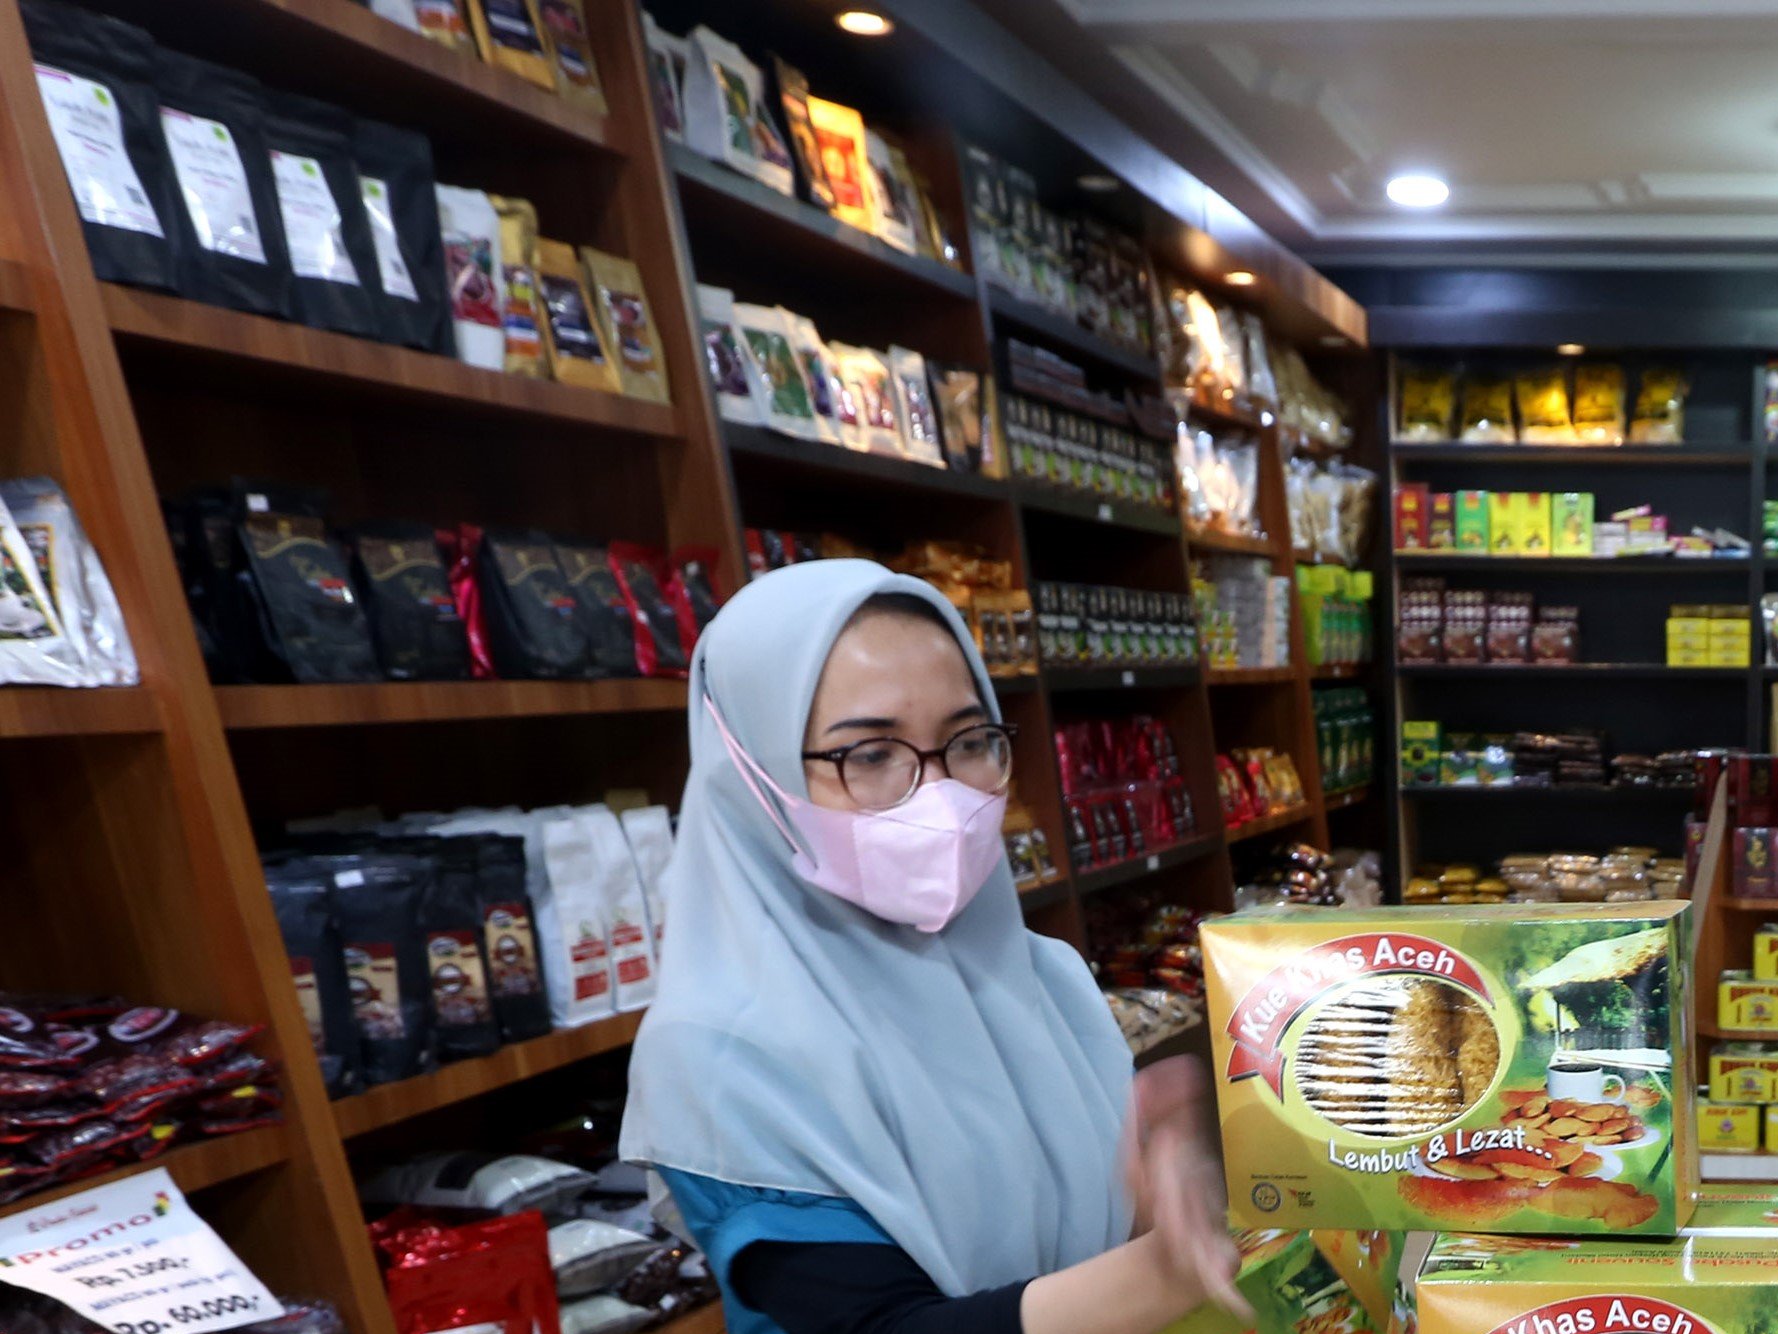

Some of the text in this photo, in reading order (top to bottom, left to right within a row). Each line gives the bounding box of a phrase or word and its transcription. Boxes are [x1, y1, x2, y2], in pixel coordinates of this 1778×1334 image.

[1240, 989, 1289, 1044] Kue
[1372, 937, 1456, 975] Aceh
[1328, 1138, 1418, 1173] Lembut
[1426, 1138, 1450, 1162] &
